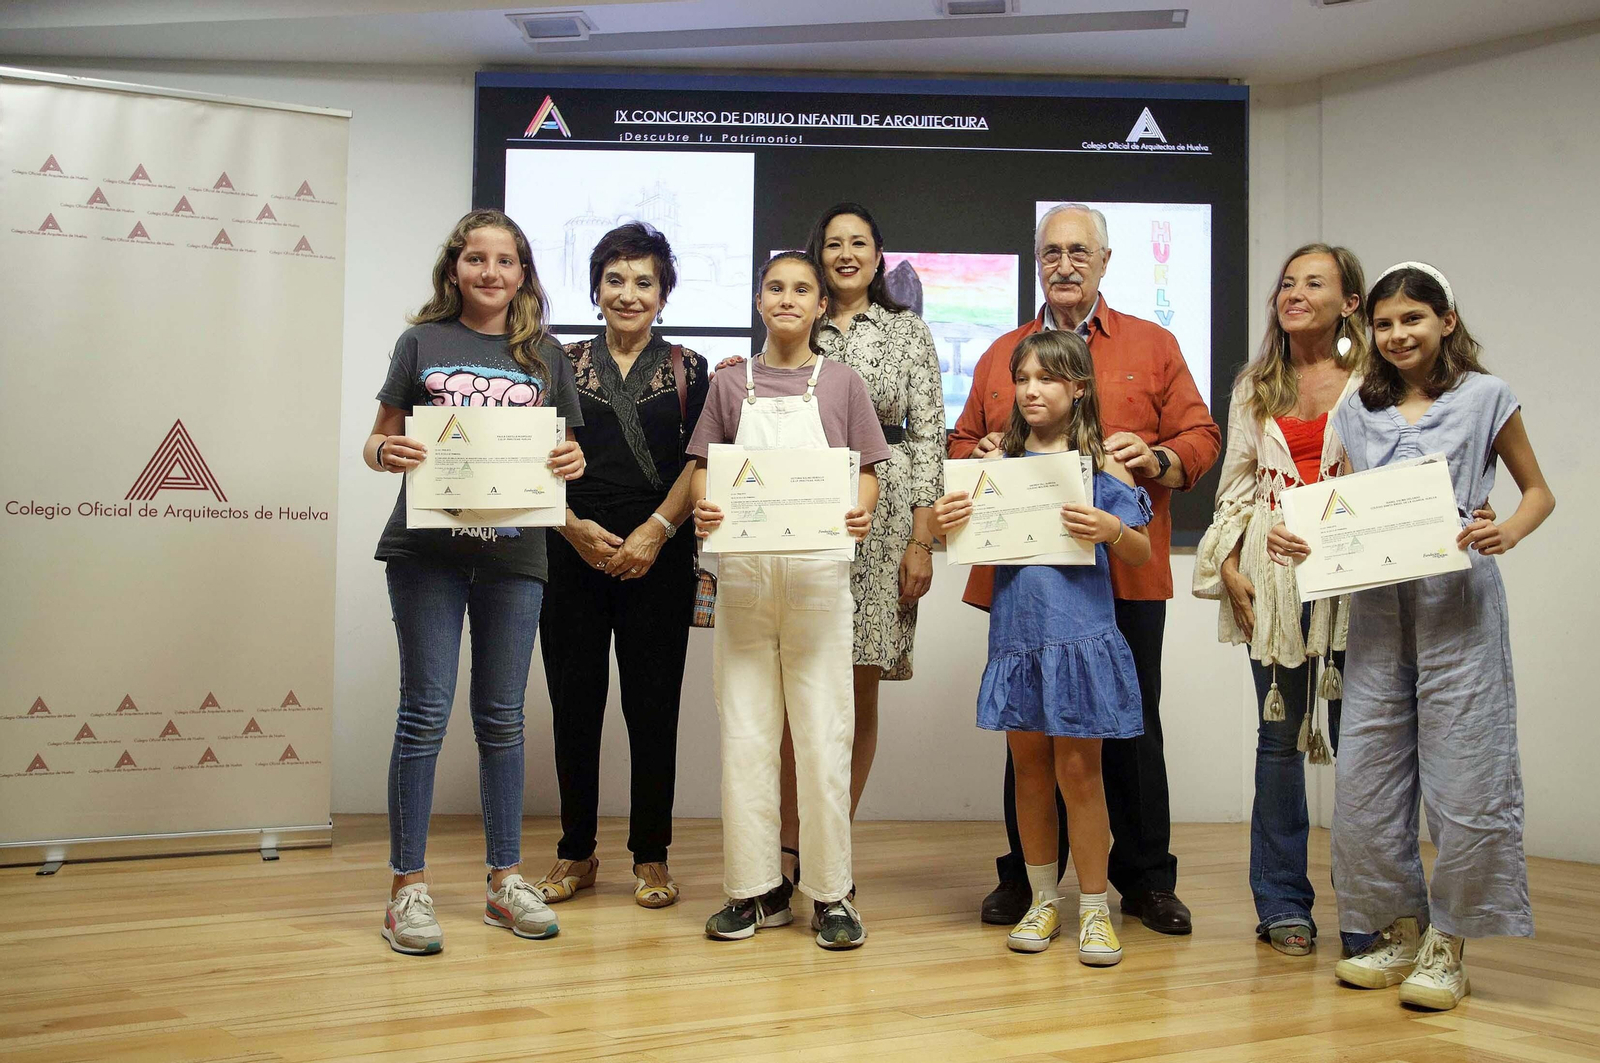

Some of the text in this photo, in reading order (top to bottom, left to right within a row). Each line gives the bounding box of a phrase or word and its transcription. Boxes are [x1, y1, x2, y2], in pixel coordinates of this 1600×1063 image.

[615, 110, 988, 128] IX CONCURSO DE DIBUJO INFANTIL DE ARQUITECTURA
[620, 132, 803, 144] ¡Descubre tu Patrimonio!
[1082, 142, 1106, 150] Colegio
[1108, 142, 1130, 150] Oficial
[1141, 143, 1175, 152] Arquitectos
[1151, 220, 1174, 326] HUELV
[5, 500, 328, 522] Colegio Oficial de Arquitectos de Huelva
